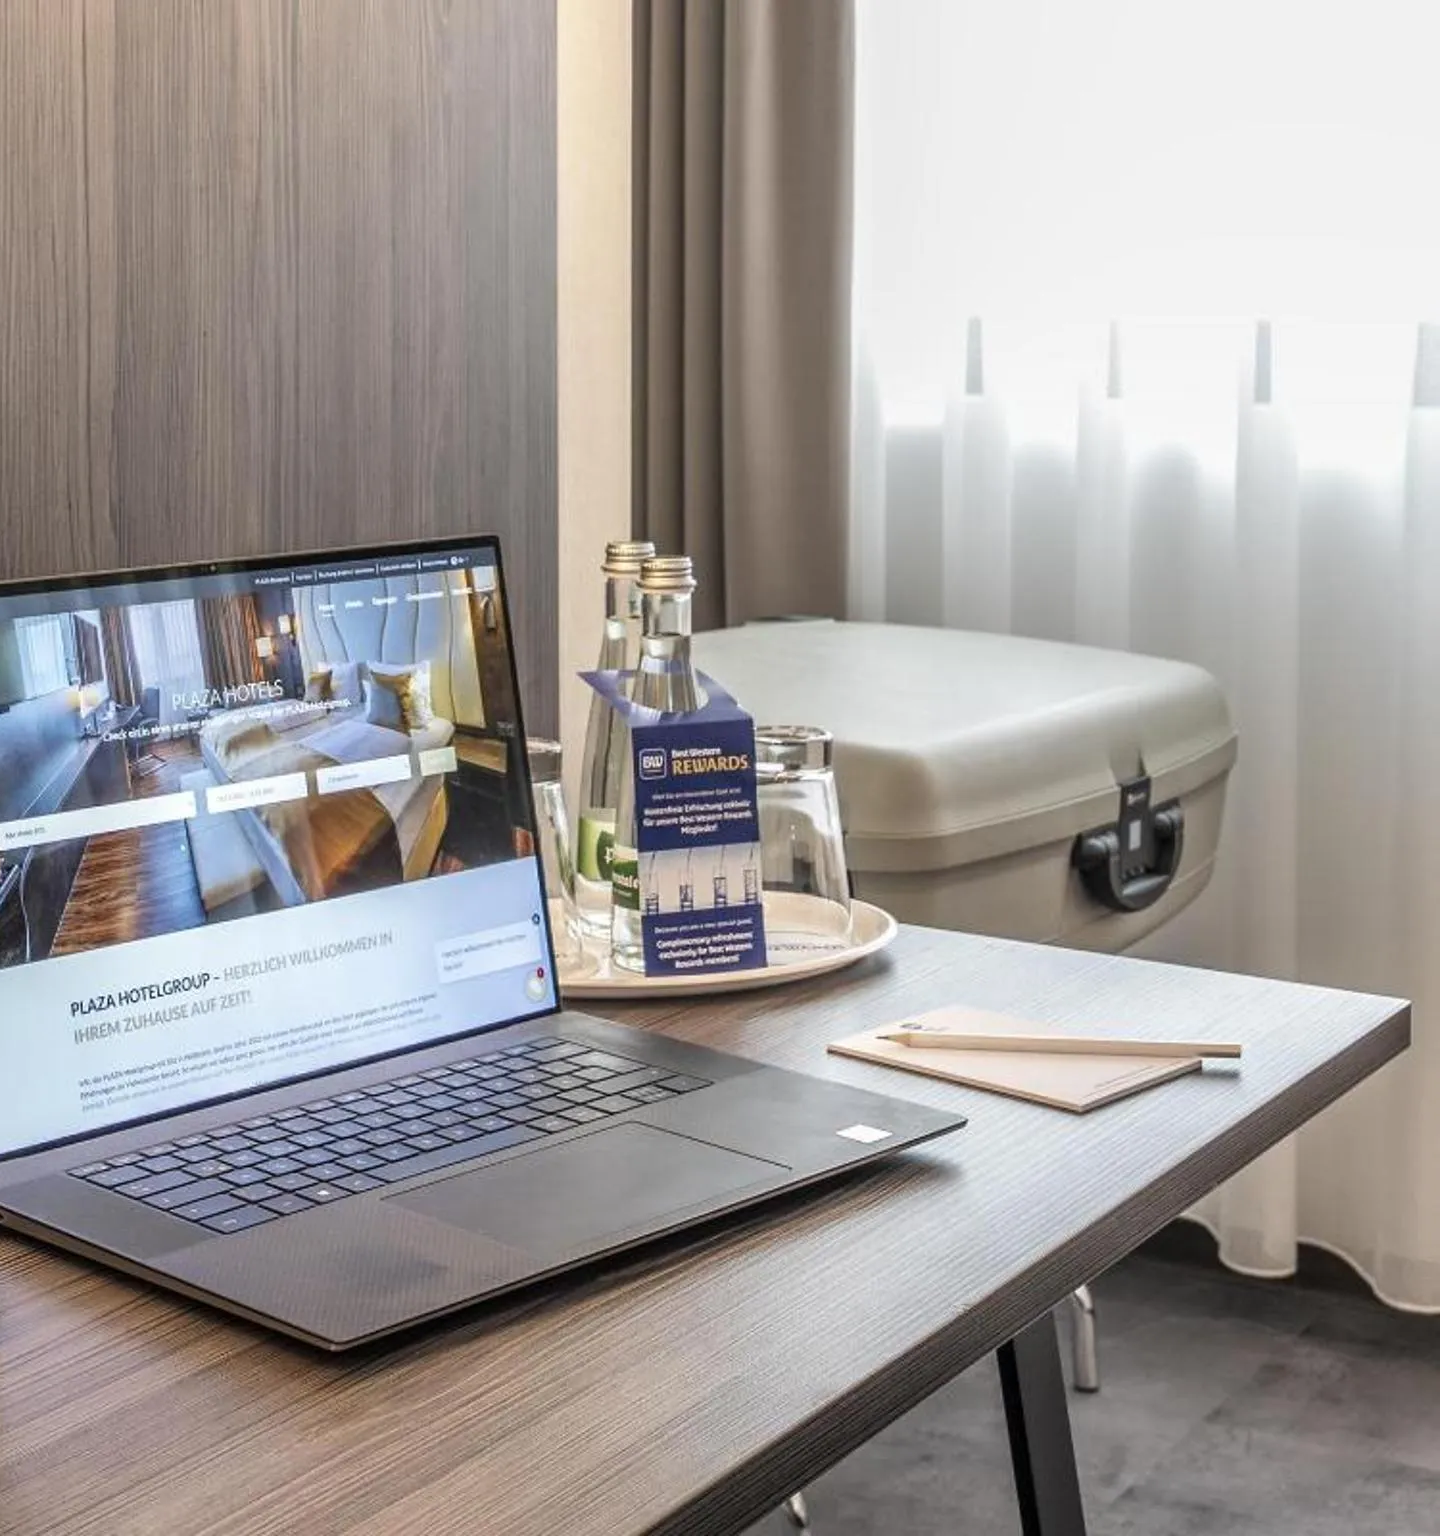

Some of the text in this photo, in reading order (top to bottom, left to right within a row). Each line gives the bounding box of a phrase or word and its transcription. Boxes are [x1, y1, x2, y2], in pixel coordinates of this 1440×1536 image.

[172, 679, 283, 710] PLAZA HOTELS
[672, 755, 748, 776] REWARDS
[69, 992, 116, 1018] PLAZA
[117, 970, 211, 1007] HOTELGROUP
[222, 954, 287, 983] HERZLICH
[288, 933, 378, 968] WILLKOMMEN
[378, 929, 393, 946] IN
[73, 988, 252, 1045] IHREM ZUHAUSE AUF ZEIT!
